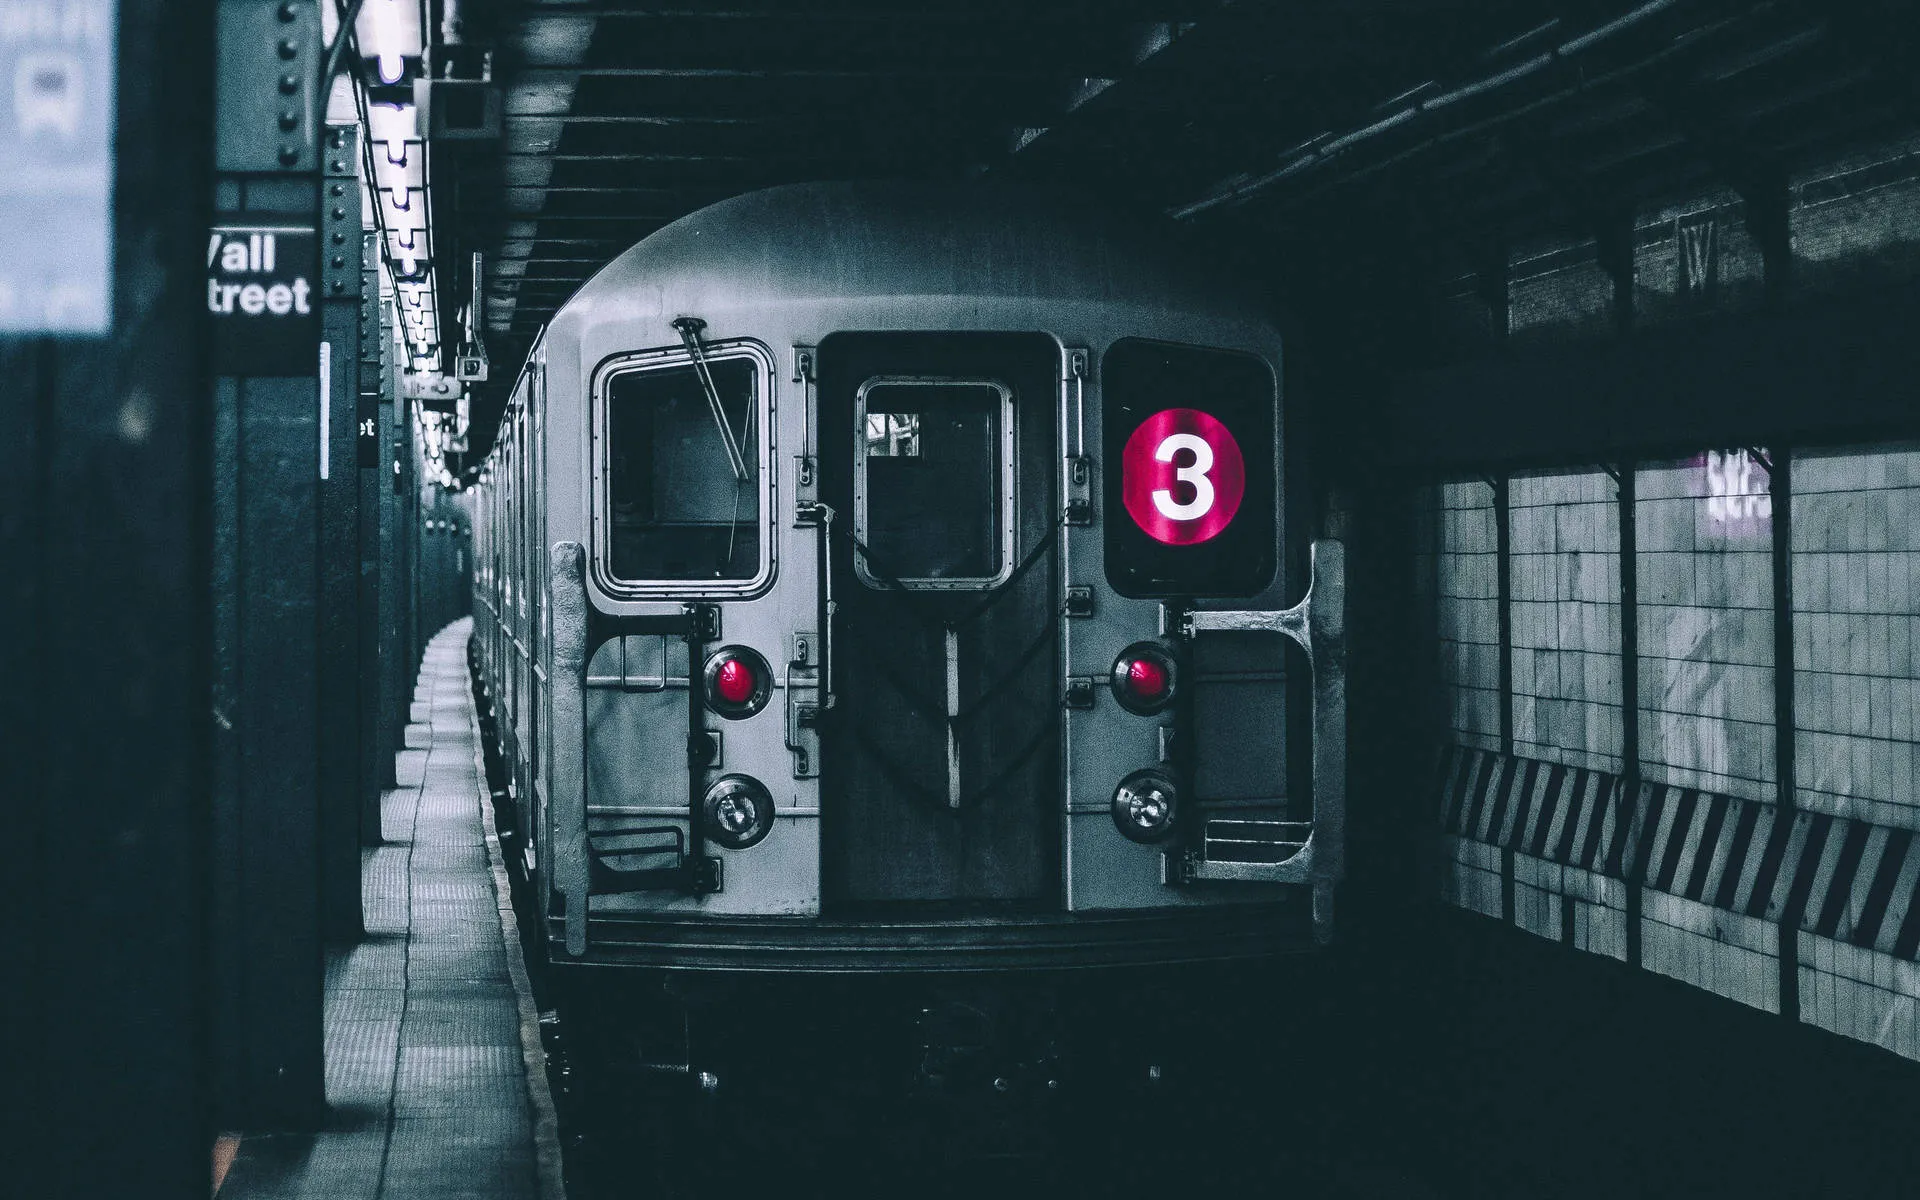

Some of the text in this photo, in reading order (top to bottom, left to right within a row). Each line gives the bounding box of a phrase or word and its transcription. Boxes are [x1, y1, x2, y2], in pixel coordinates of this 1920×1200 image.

[207, 234, 276, 272] all
[1682, 221, 1714, 290] W
[207, 277, 311, 314] treet
[1152, 433, 1215, 521] 3
